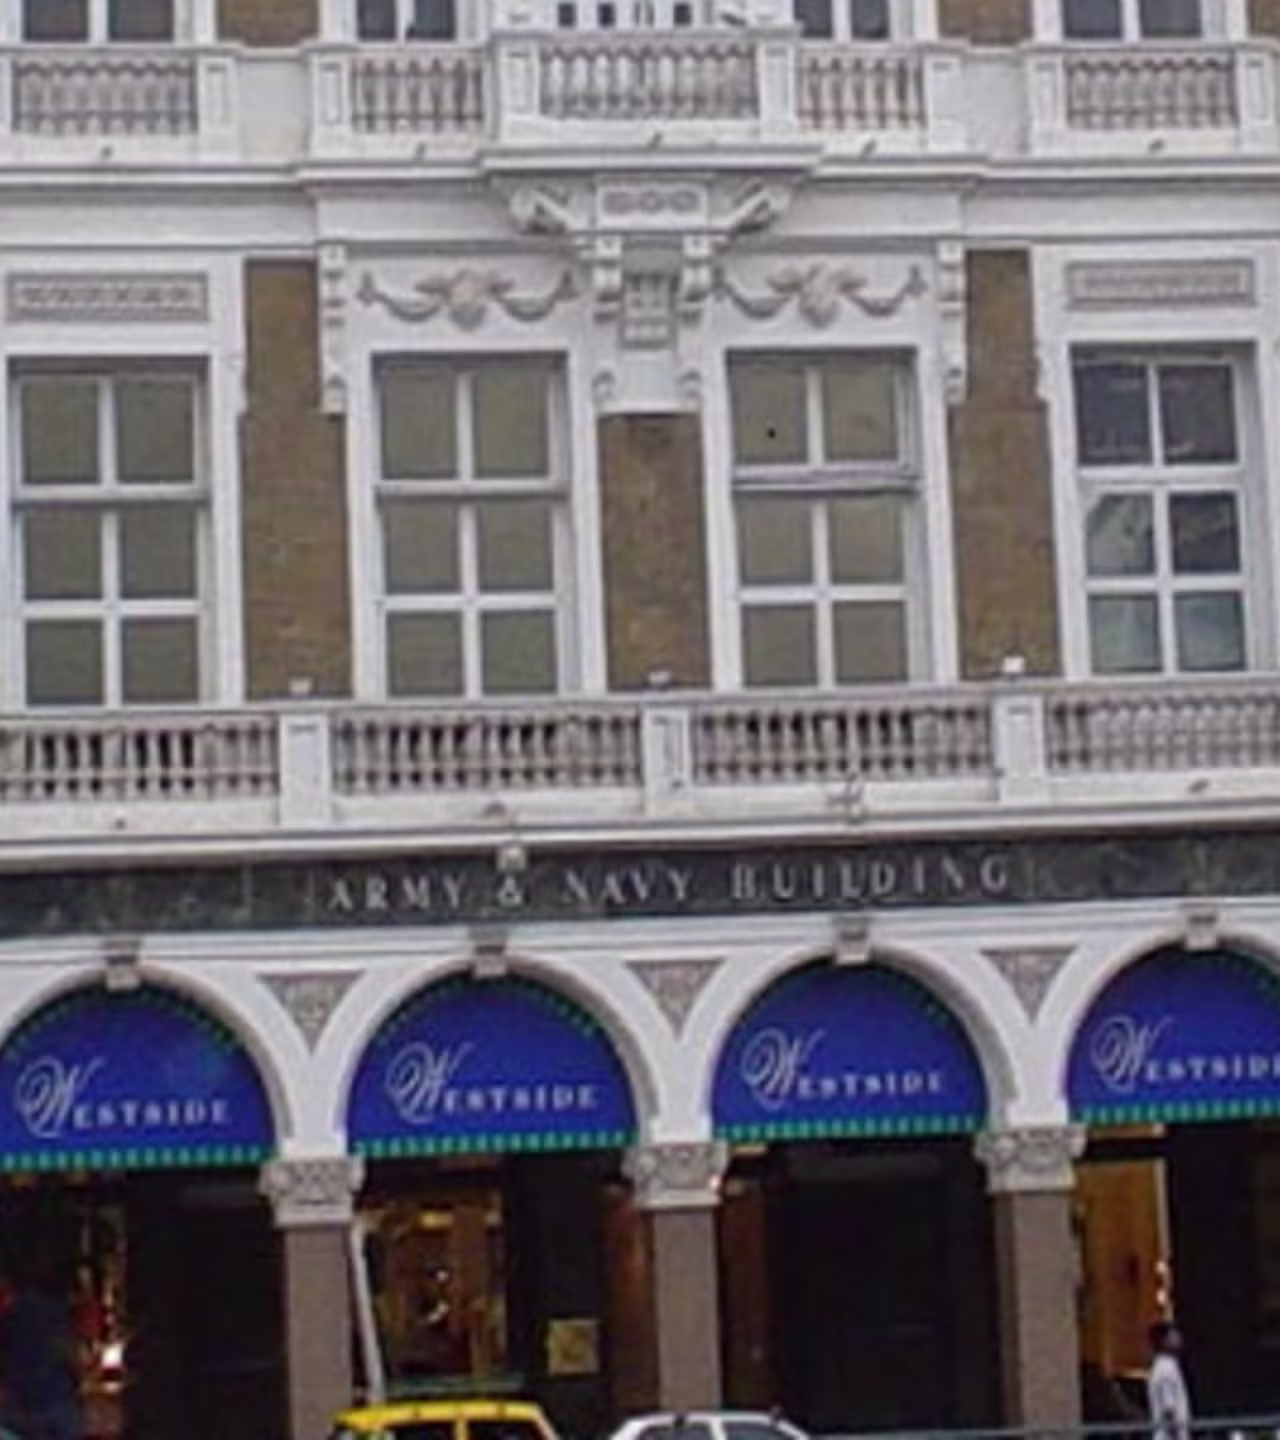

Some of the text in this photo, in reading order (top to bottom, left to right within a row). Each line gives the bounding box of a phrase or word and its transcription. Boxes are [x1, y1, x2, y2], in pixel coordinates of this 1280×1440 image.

[327, 855, 1008, 910] ARMY & NAVY BUILDING
[19, 1056, 231, 1138] WESTSIDE
[385, 1040, 600, 1124] WESTSIDE
[742, 1026, 944, 1110] WESTSIDE
